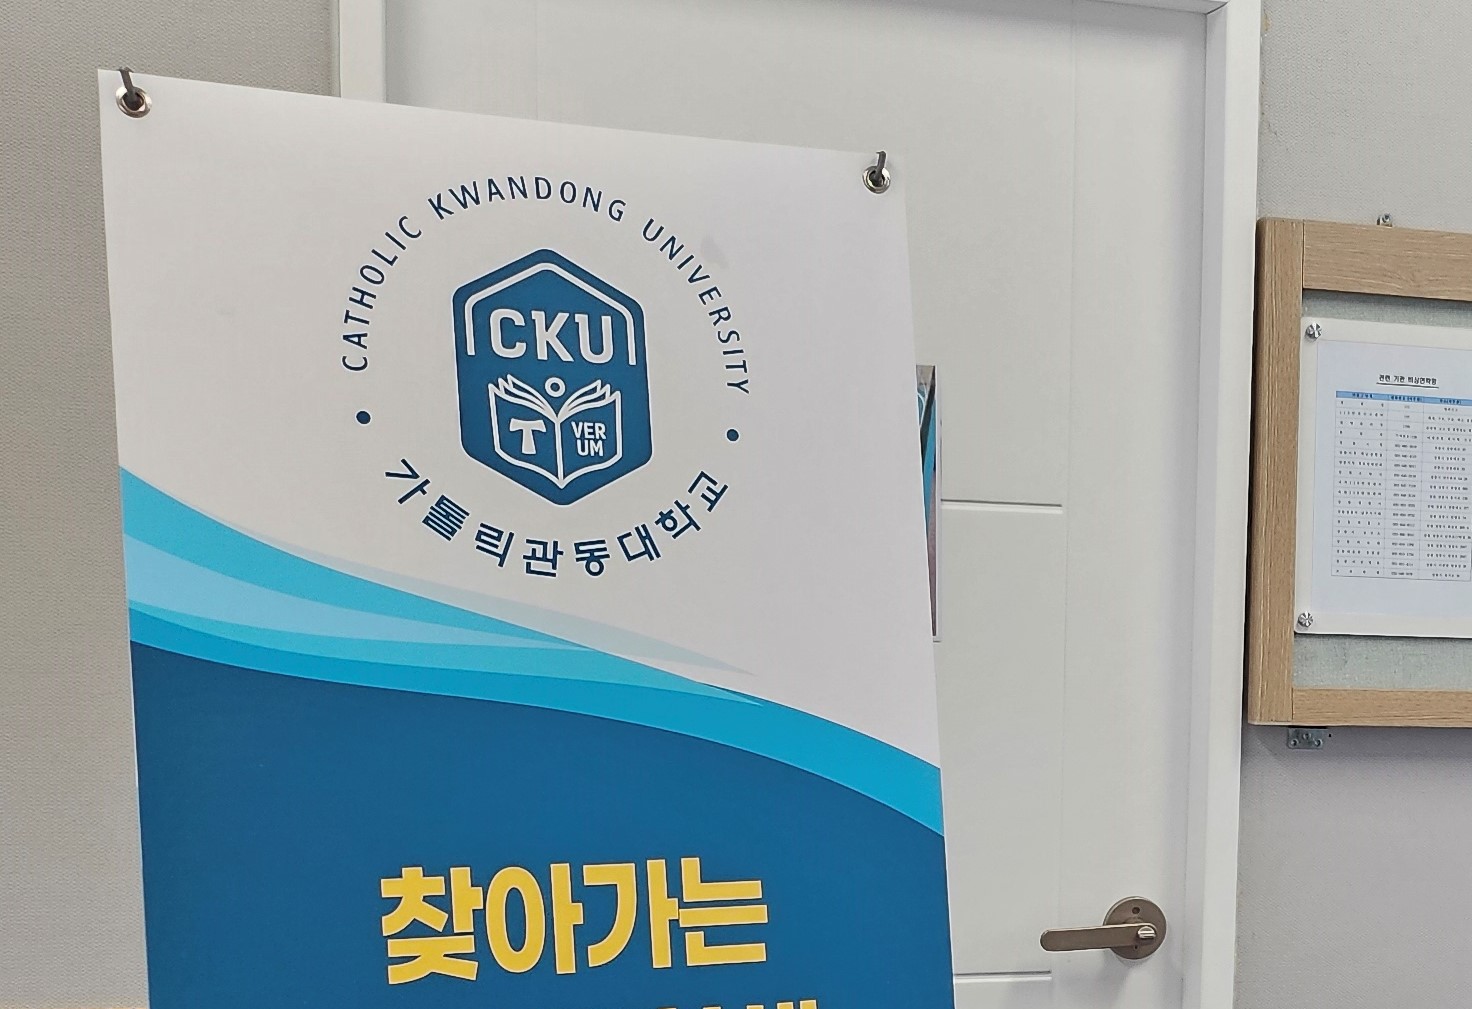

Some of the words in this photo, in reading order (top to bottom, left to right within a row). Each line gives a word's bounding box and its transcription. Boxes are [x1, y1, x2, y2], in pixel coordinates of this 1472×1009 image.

[342, 216, 421, 371] CATHOLIC
[428, 177, 625, 221] KWANDONG
[641, 217, 751, 396] UNIVERSITY
[489, 307, 617, 365] CKU
[386, 455, 728, 577] 가톨릭관동대학교
[380, 856, 768, 985] 찾아가는
